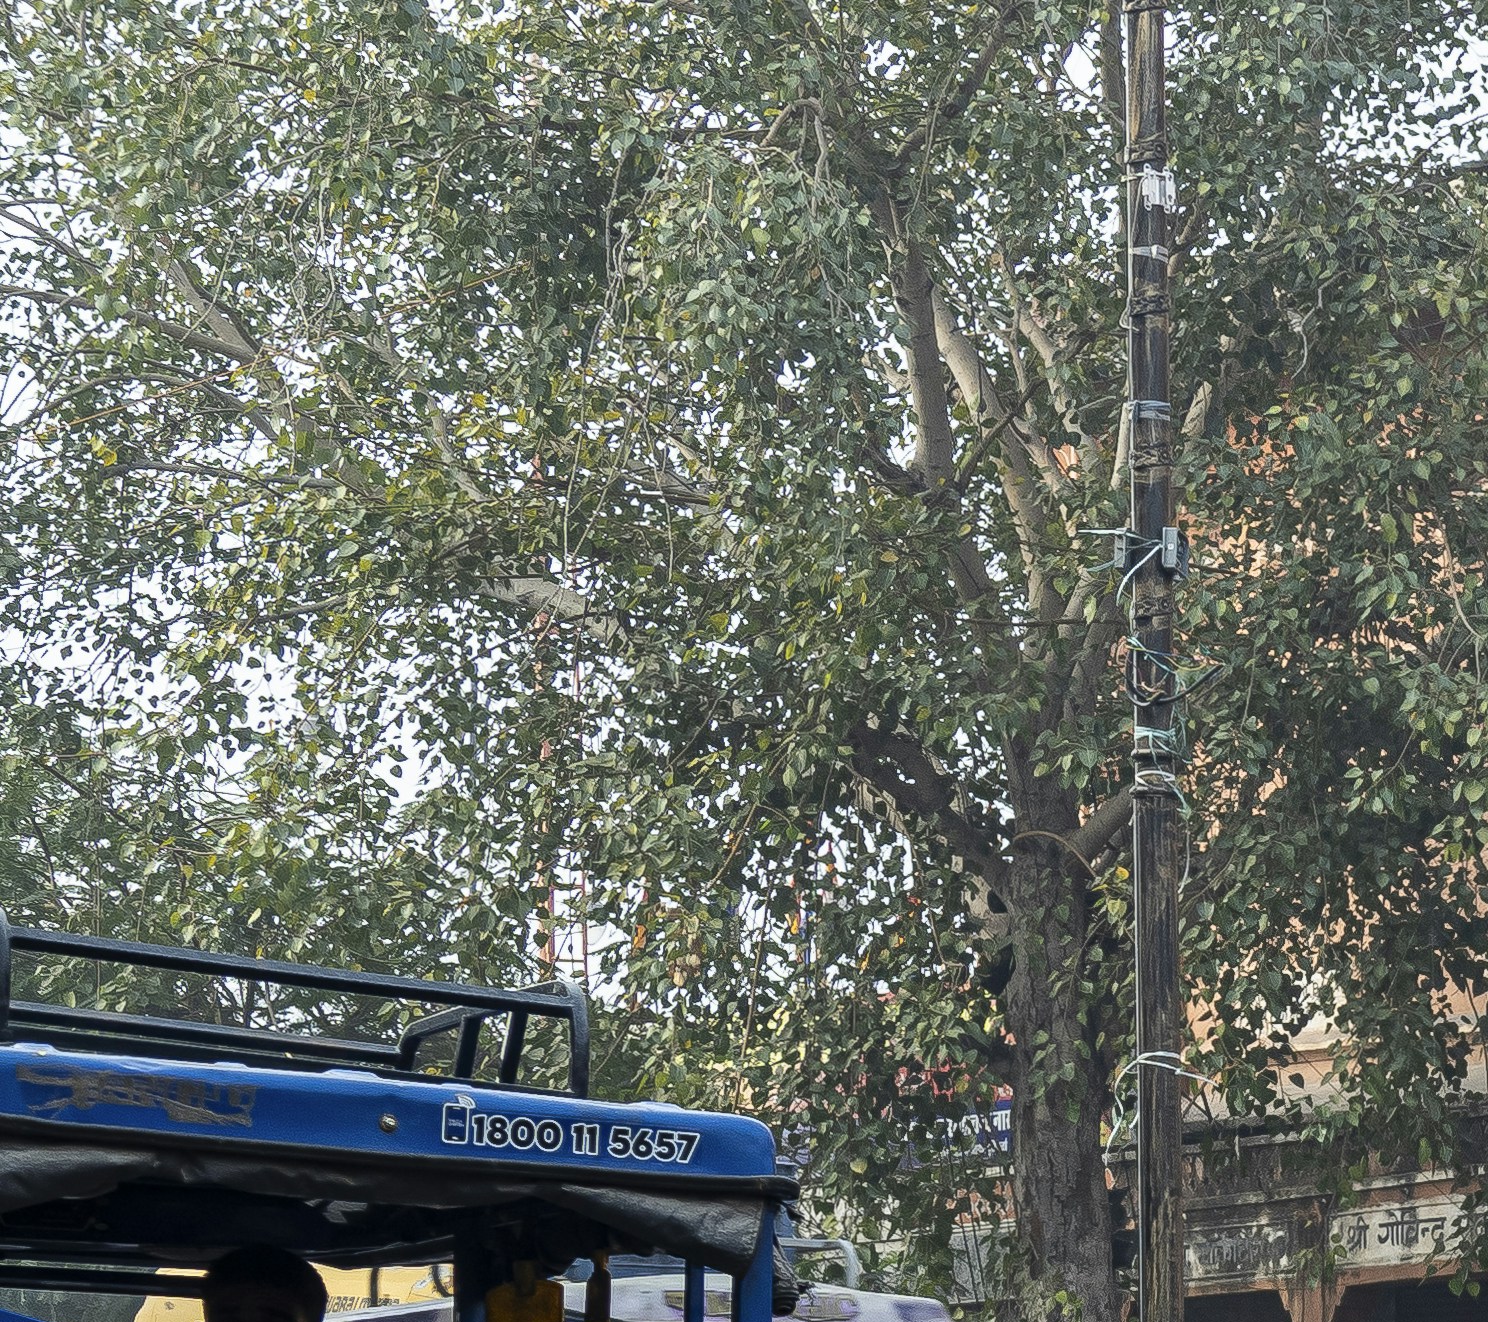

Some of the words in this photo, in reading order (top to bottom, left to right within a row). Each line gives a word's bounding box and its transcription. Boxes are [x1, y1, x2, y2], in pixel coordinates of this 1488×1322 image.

[472, 1114, 563, 1151] 1800
[571, 1123, 600, 1156] 11
[607, 1126, 700, 1163] 5657
